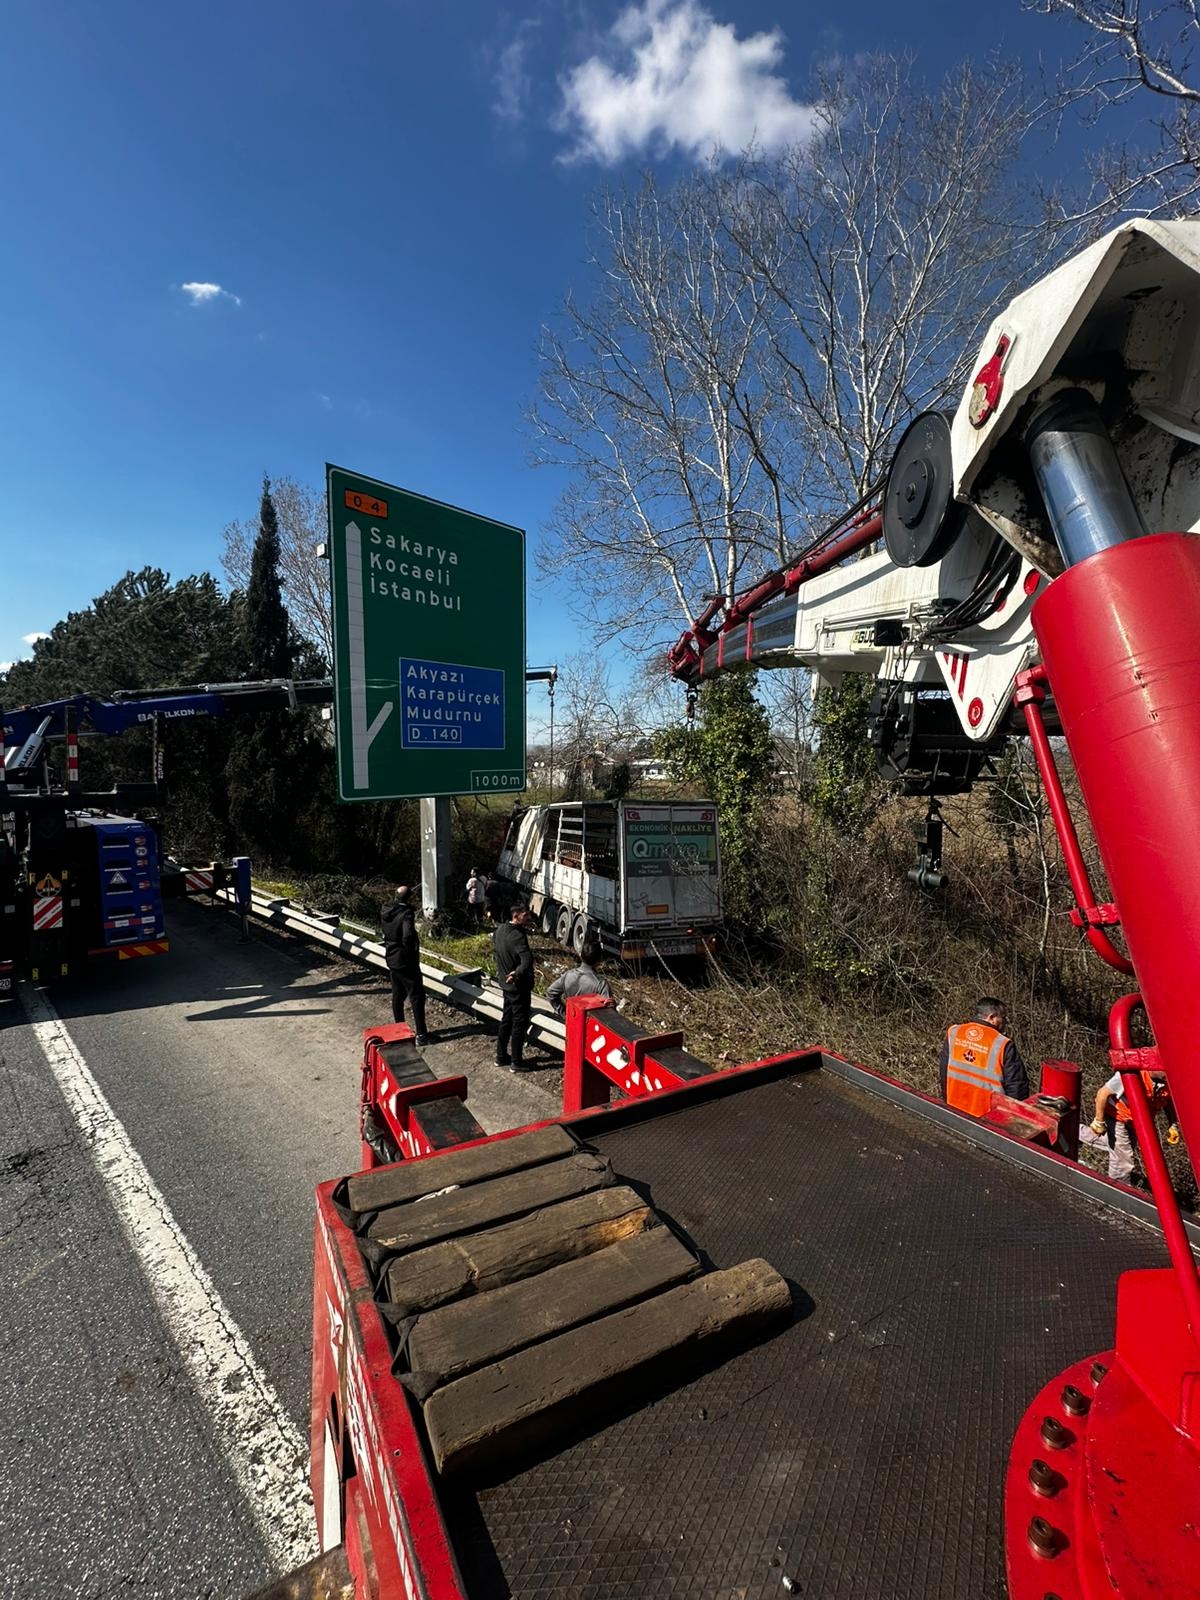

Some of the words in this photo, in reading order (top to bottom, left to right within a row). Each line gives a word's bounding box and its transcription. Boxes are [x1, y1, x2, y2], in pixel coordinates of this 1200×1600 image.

[369, 526, 458, 565] Sakarya
[370, 552, 450, 586] Kocaeli
[370, 573, 461, 611] İstanbul
[407, 665, 464, 683] Akyazı
[407, 685, 500, 705] Karapürçek
[407, 706, 482, 722] Mudurnu
[475, 775, 520, 787] 1000m
[629, 823, 668, 832] EKONOMİK
[673, 823, 712, 832] NAKLİYE
